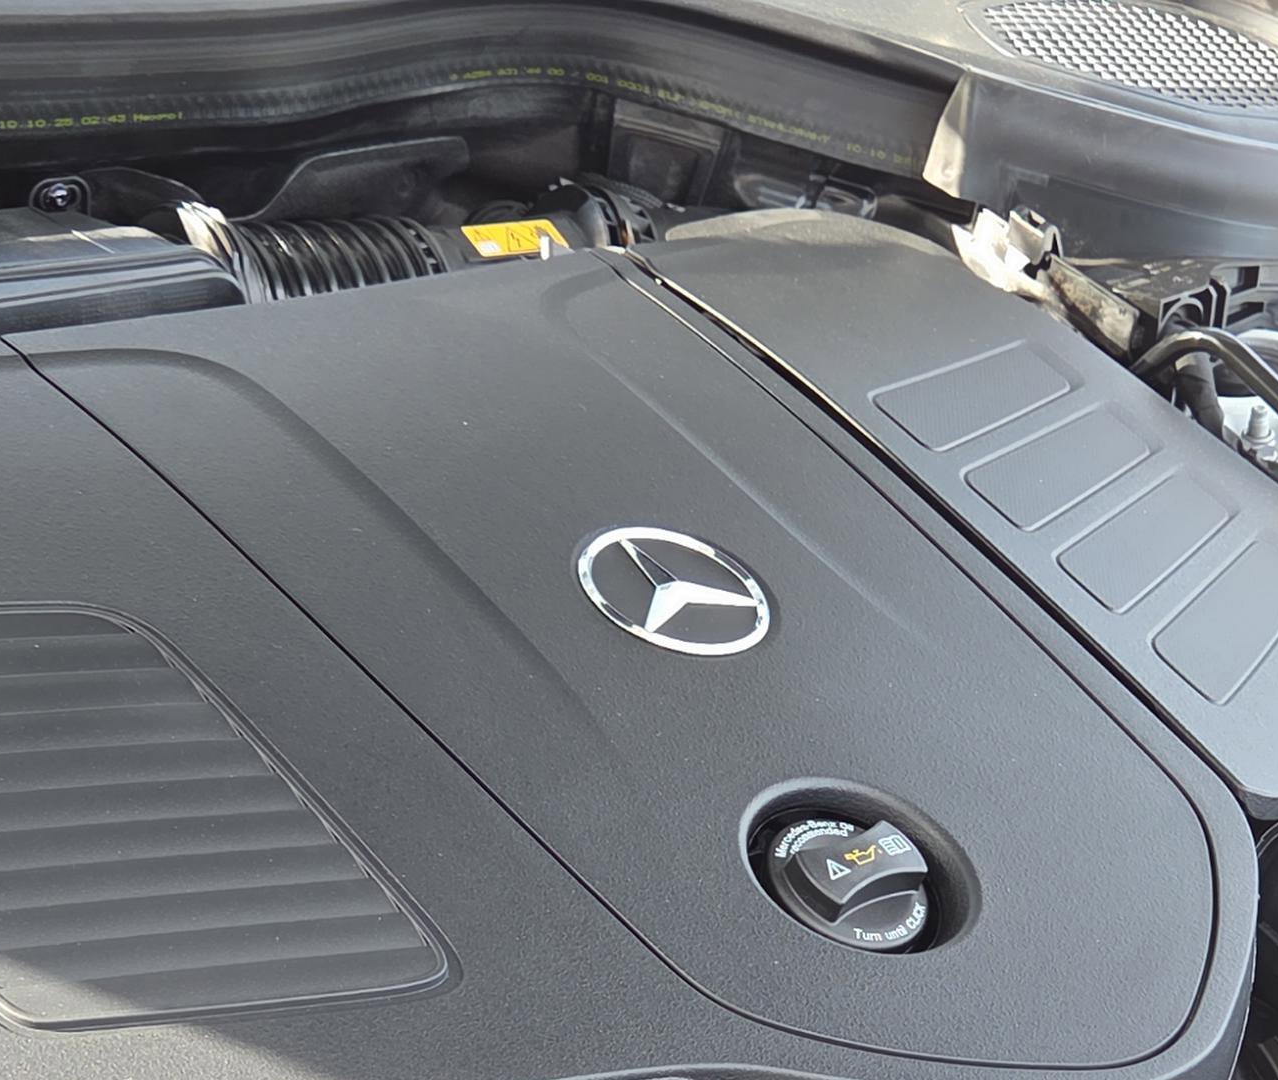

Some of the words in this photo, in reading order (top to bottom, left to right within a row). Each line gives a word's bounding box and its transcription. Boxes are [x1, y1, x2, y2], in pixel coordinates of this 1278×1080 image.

[774, 819, 838, 858] Mercedes-Benz
[853, 927, 883, 942] Turn
[884, 924, 909, 940] until
[905, 901, 927, 930] CLICK
